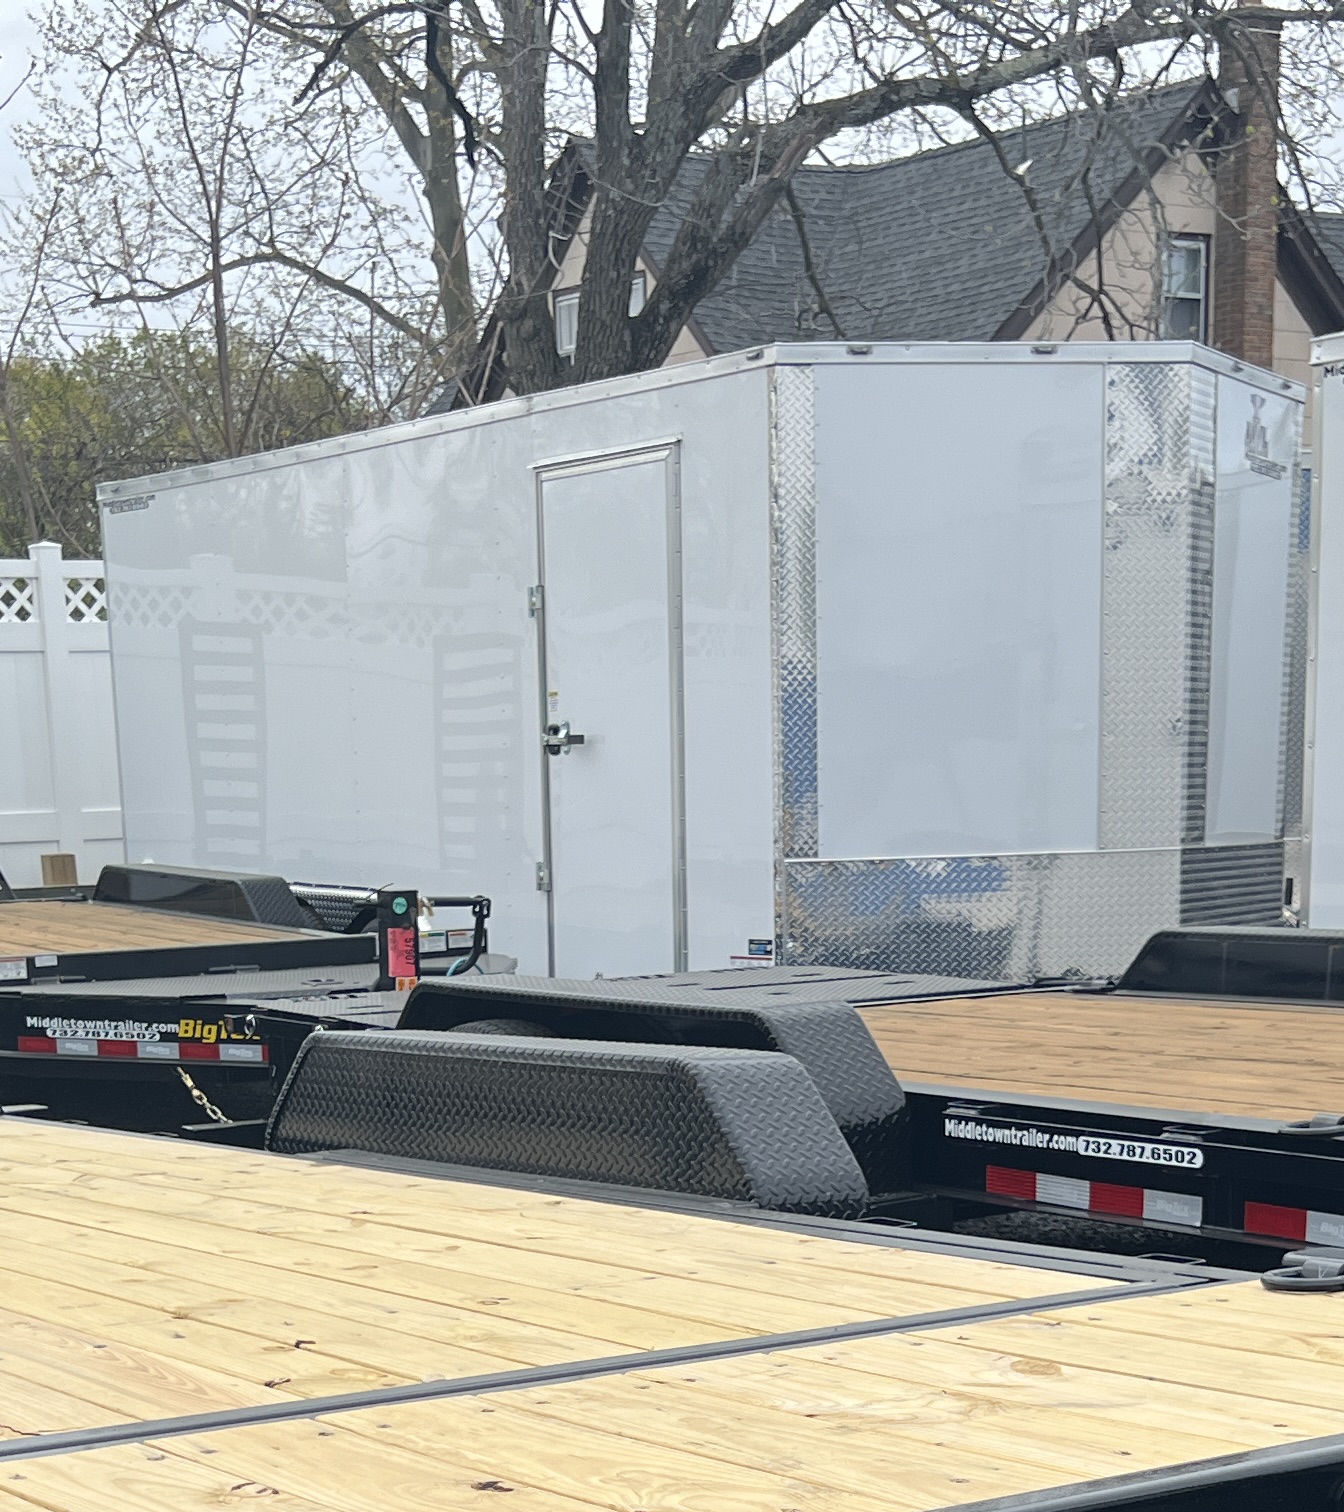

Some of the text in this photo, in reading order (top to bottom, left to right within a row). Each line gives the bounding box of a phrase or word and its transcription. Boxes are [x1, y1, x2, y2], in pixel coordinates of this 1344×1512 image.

[26, 1016, 180, 1034] Middletowntrailer.com
[178, 1019, 260, 1043] BigT
[944, 1118, 1197, 1165] Middletowntrailer.com 732.787.6502
